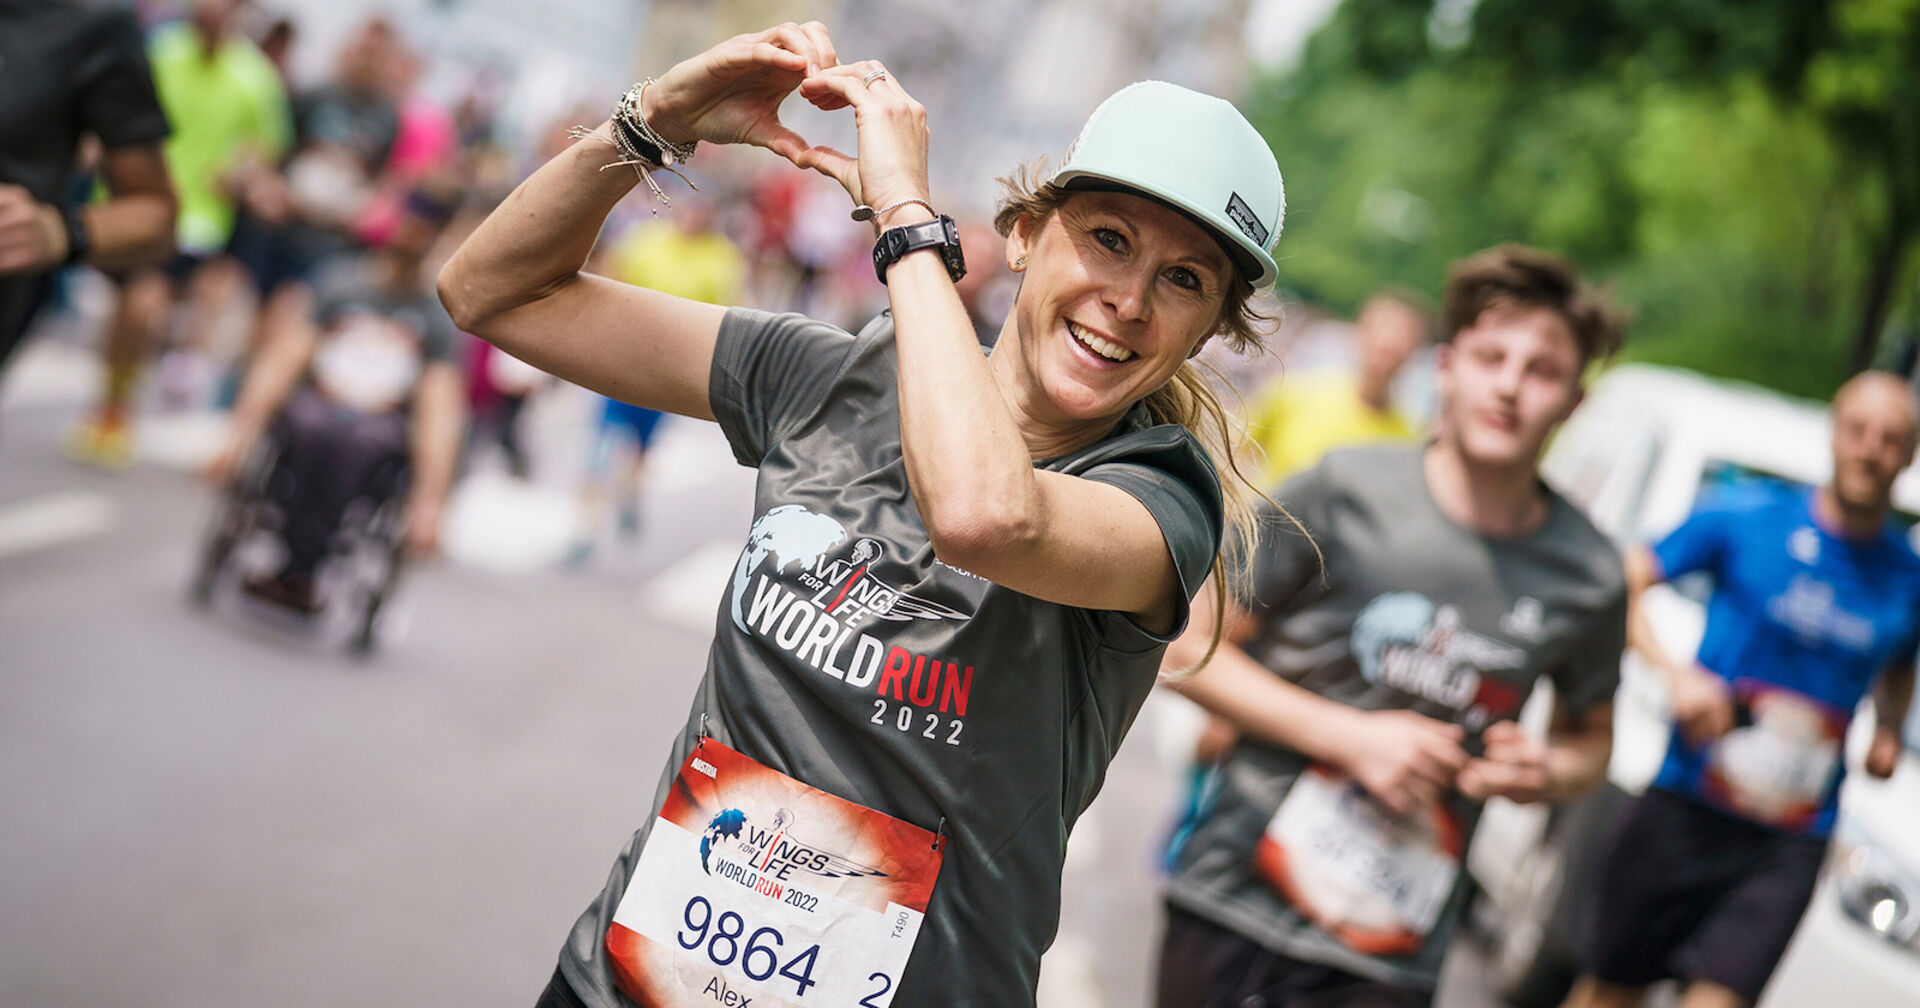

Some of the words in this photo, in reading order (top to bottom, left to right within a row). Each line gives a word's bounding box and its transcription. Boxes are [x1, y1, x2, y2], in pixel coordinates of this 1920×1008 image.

[798, 572, 824, 591] FOR
[810, 583, 872, 628] LIFE
[870, 699, 964, 745] 2022
[690, 757, 718, 780] AUSTRIA
[738, 843, 756, 855] FOR
[748, 848, 798, 881] LIFE
[749, 826, 830, 871] WINGS
[784, 888, 819, 913] 2022
[891, 911, 910, 939] T490
[677, 895, 820, 997] 9864
[703, 976, 752, 1008] Alex
[858, 972, 892, 1008] 2
